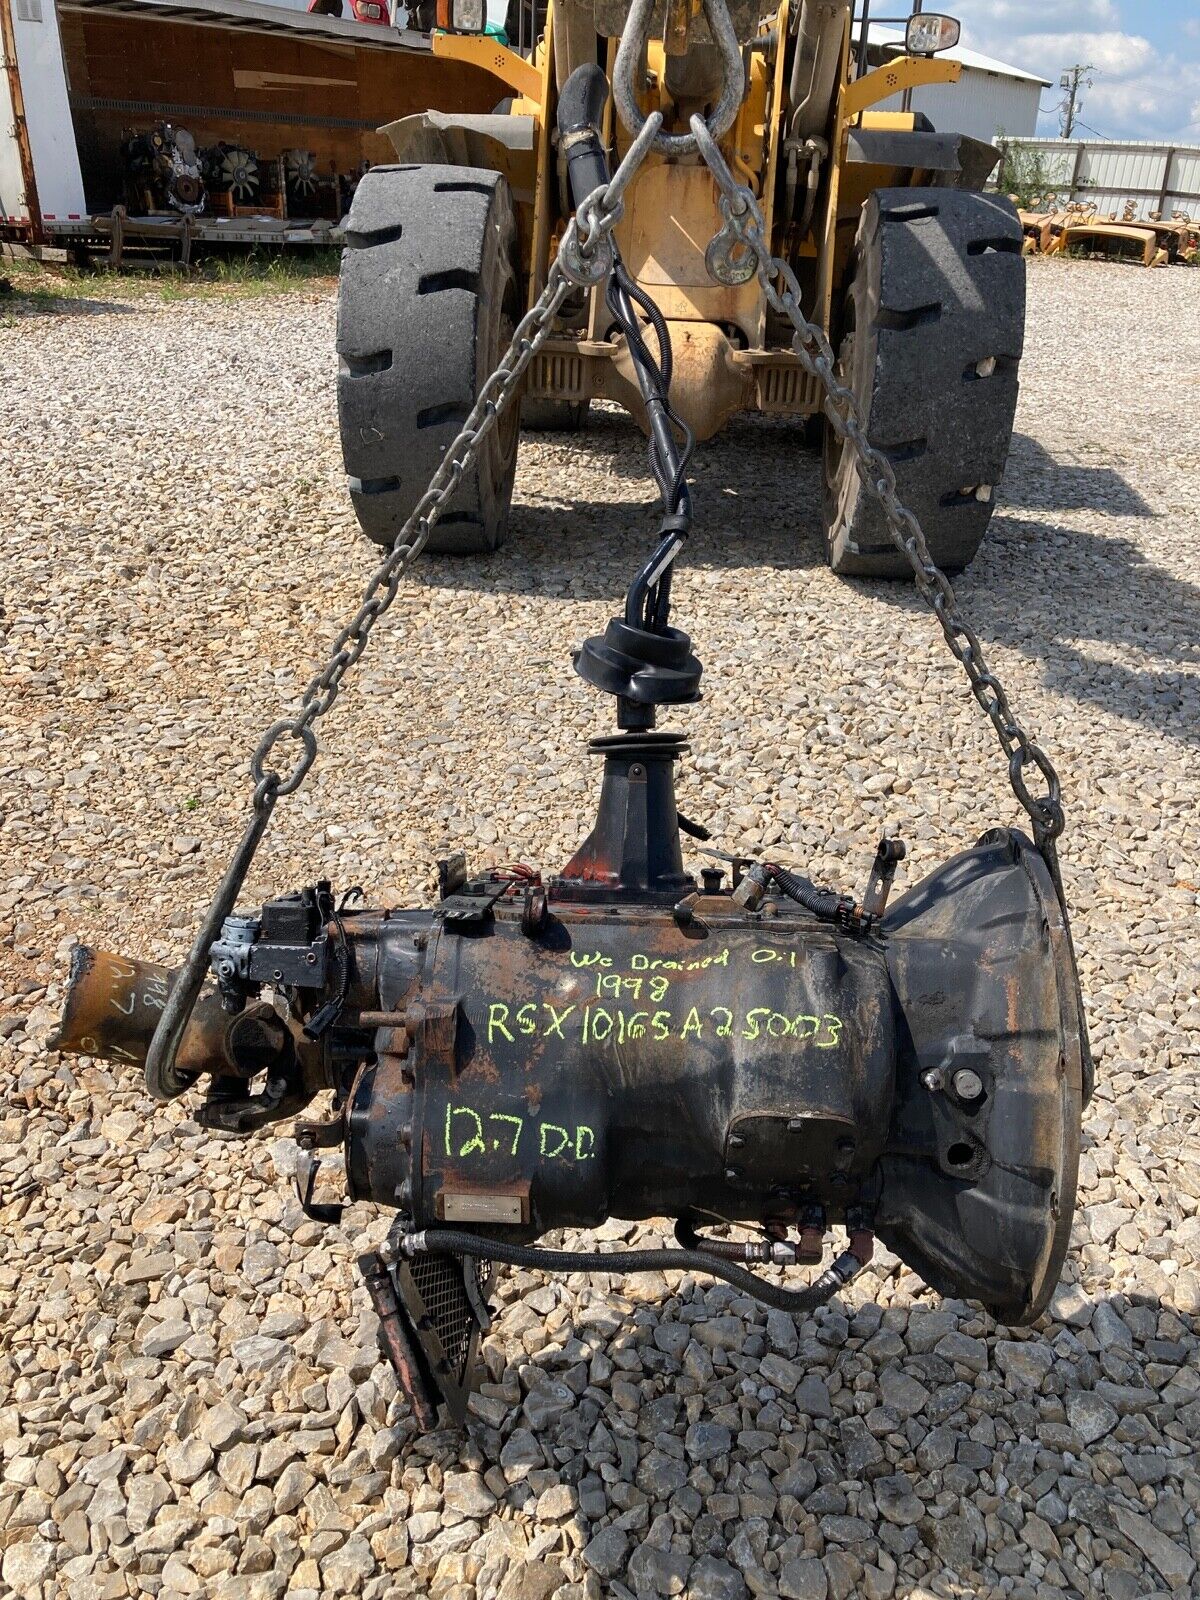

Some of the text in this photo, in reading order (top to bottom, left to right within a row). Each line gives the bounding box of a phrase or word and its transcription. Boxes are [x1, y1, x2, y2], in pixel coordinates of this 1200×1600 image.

[631, 949, 730, 971] Drained
[751, 949, 796, 968] Oil
[596, 972, 670, 1002] 1998
[445, 1102, 524, 1157] 12.7
